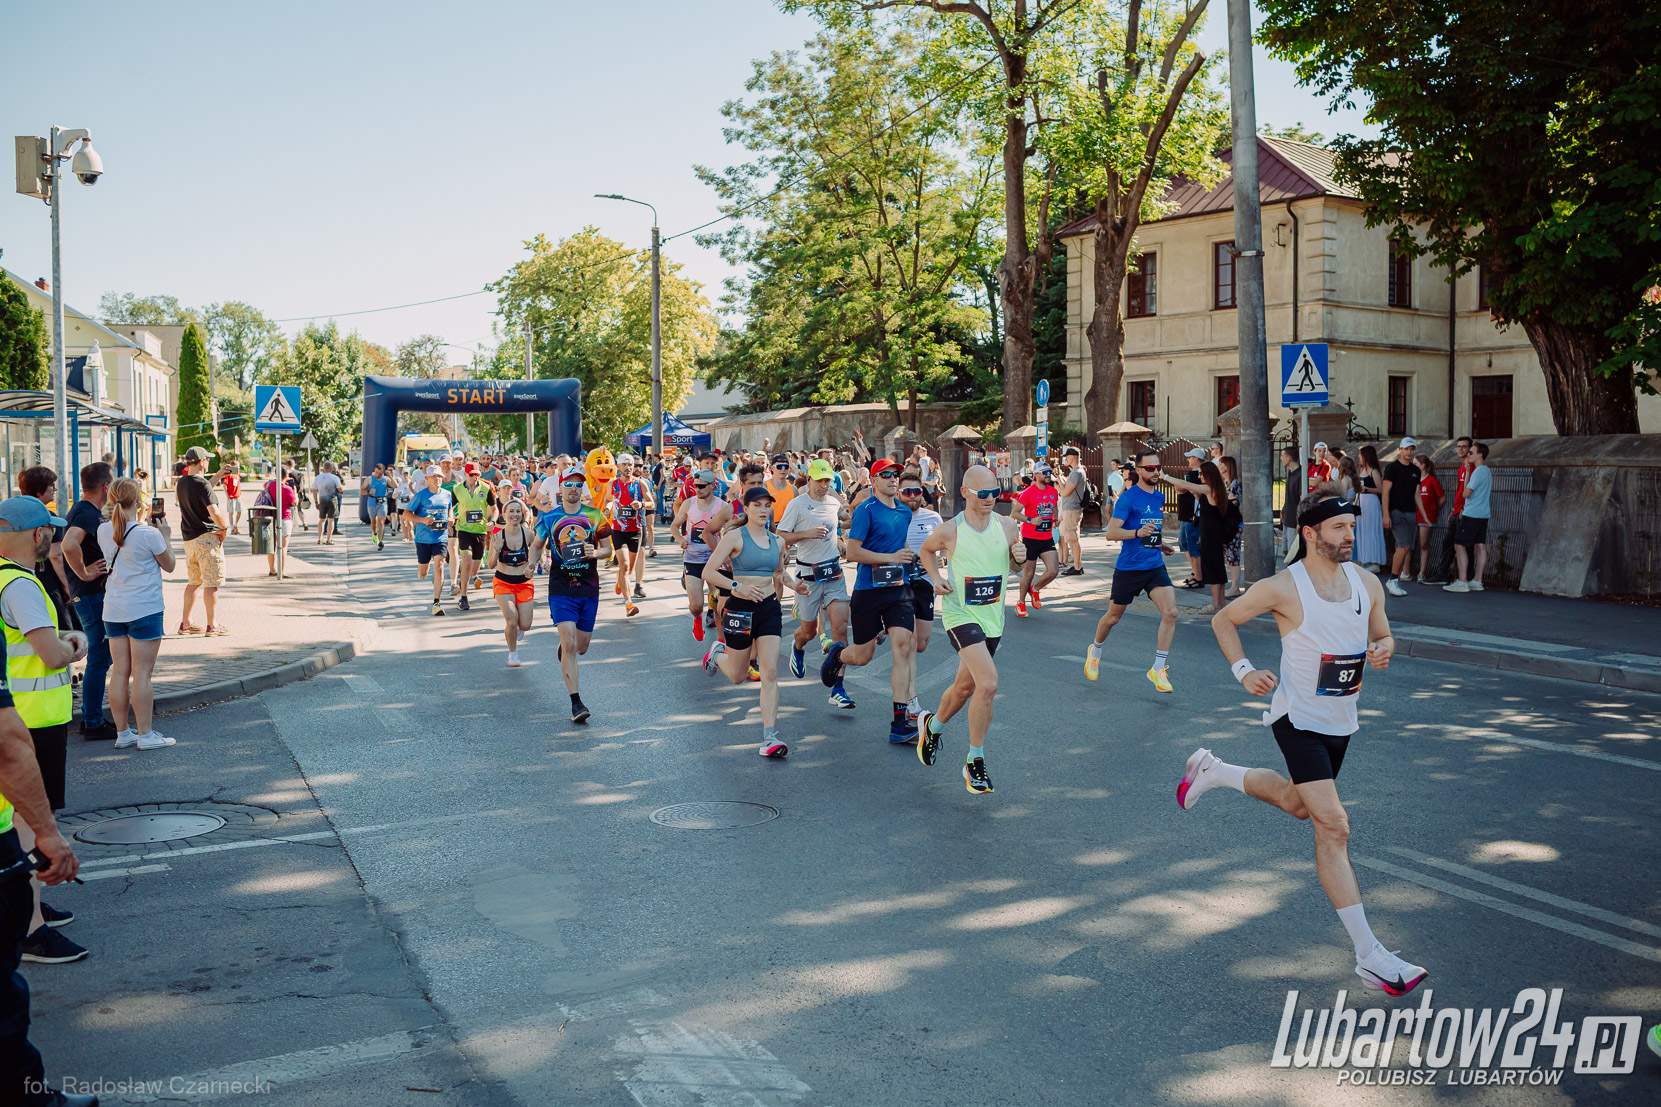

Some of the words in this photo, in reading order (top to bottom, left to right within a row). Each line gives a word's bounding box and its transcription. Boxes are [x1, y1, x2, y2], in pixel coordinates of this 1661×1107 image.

[447, 388, 507, 404] START
[570, 547, 582, 557] 75
[823, 568, 833, 576] 78
[886, 571, 892, 579] 5
[975, 586, 994, 596] 126
[729, 619, 740, 628] 60
[1338, 669, 1356, 683] 87
